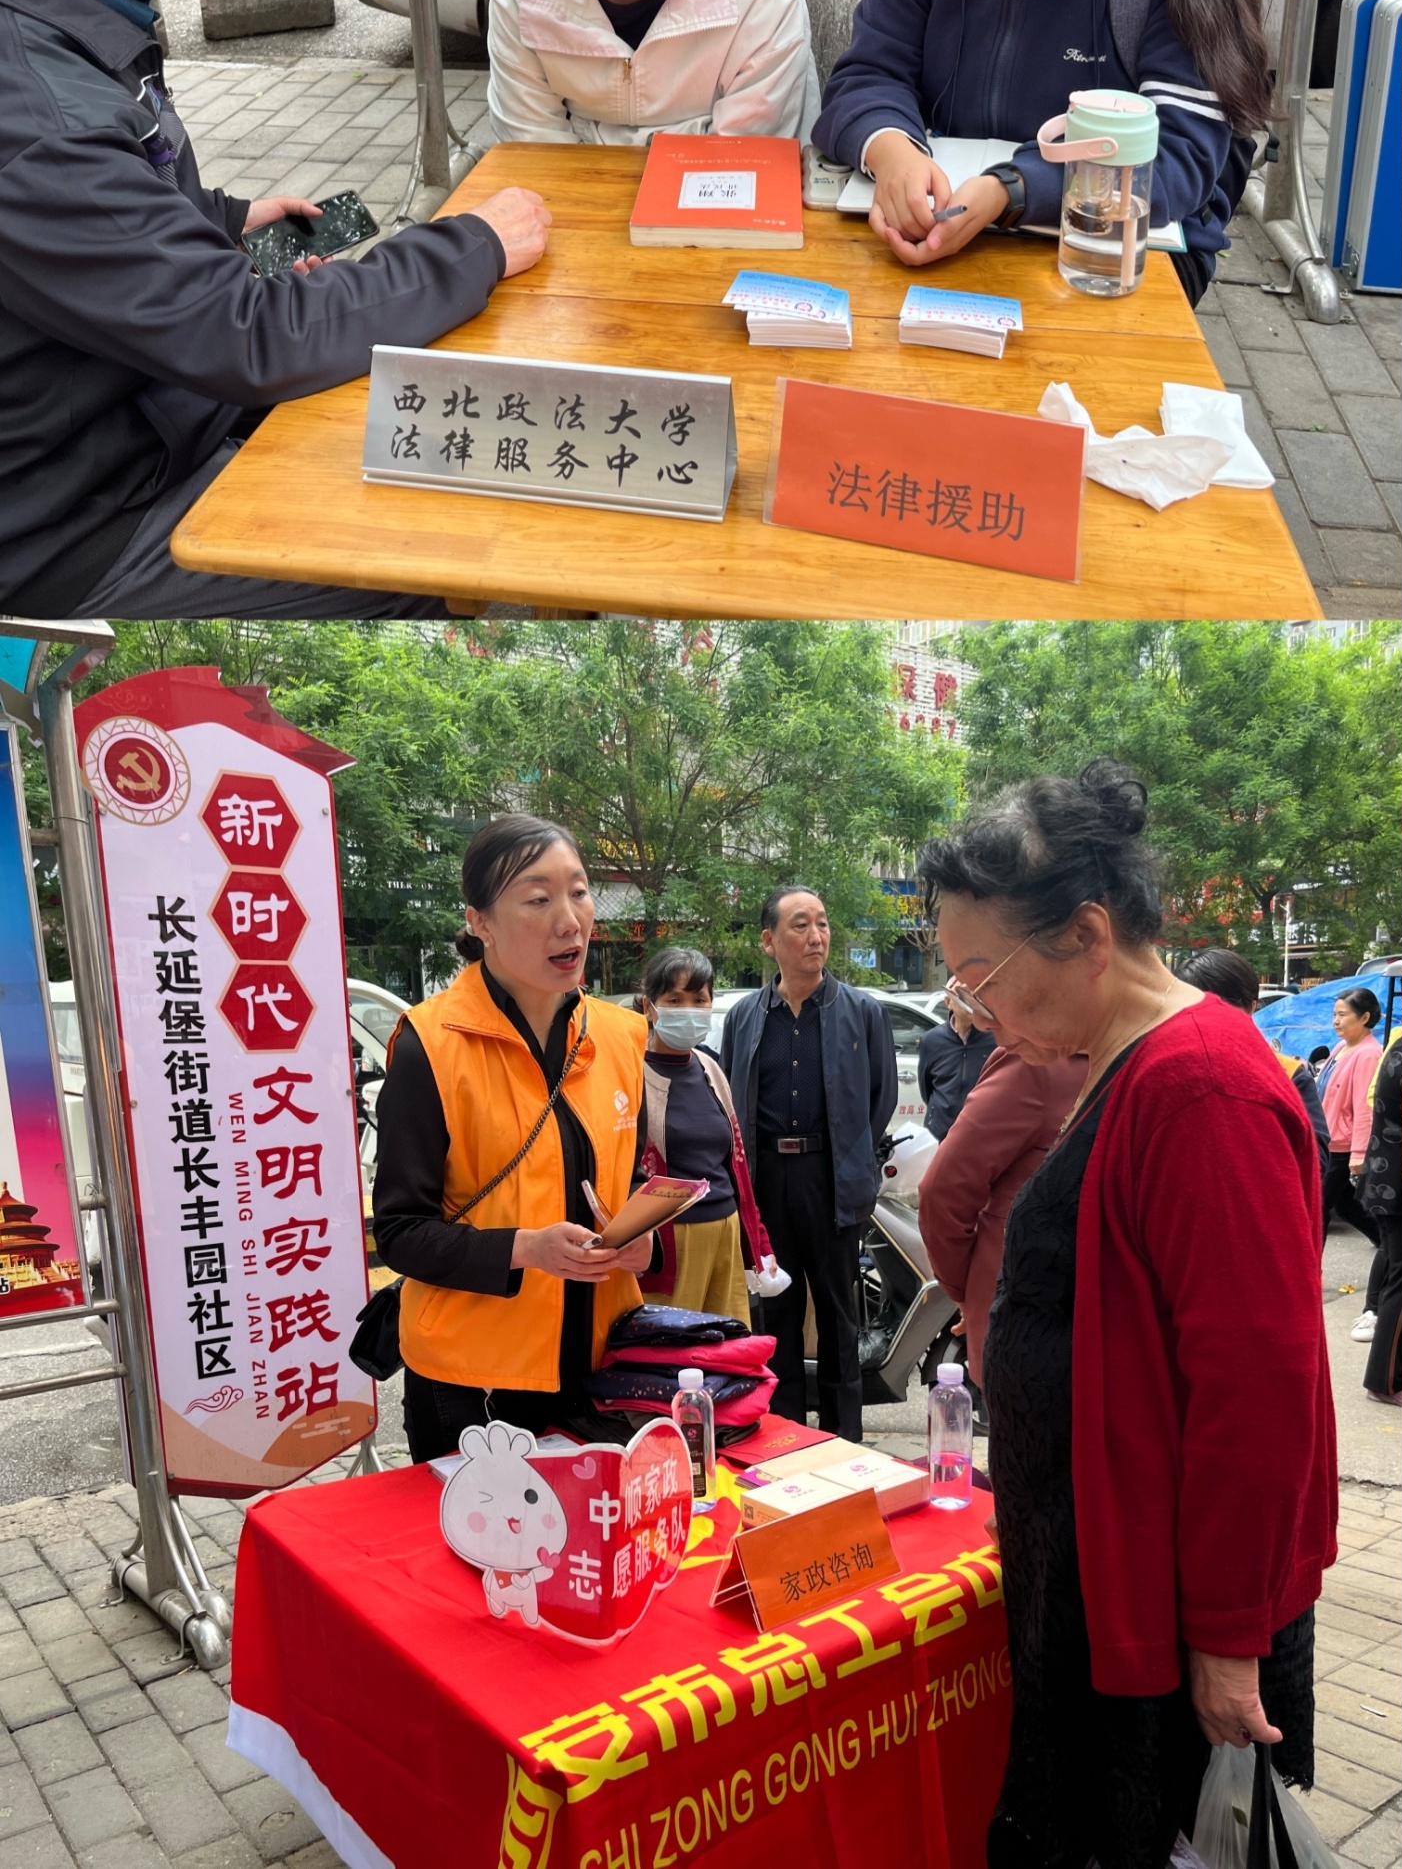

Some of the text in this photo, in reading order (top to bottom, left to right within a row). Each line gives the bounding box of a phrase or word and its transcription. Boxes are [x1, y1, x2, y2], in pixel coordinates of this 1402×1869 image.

[389, 424, 697, 487] 法律服务中心
[390, 382, 696, 447] 西北政法大学
[825, 458, 1027, 544] 法律援助
[147, 895, 237, 1380] 长延堡街道长丰园社区
[217, 793, 341, 1422] 新时代文明实践站
[228, 1092, 270, 1421] WEN MING SHI JIAN ZHAN
[589, 1454, 679, 1542] 中顺家政
[568, 1514, 687, 1603] 志愿服务队
[778, 1540, 875, 1605] 家政咨询
[649, 1768, 754, 1869] ZONG
[763, 1718, 861, 1808] GONG
[867, 1700, 919, 1760] HUI
